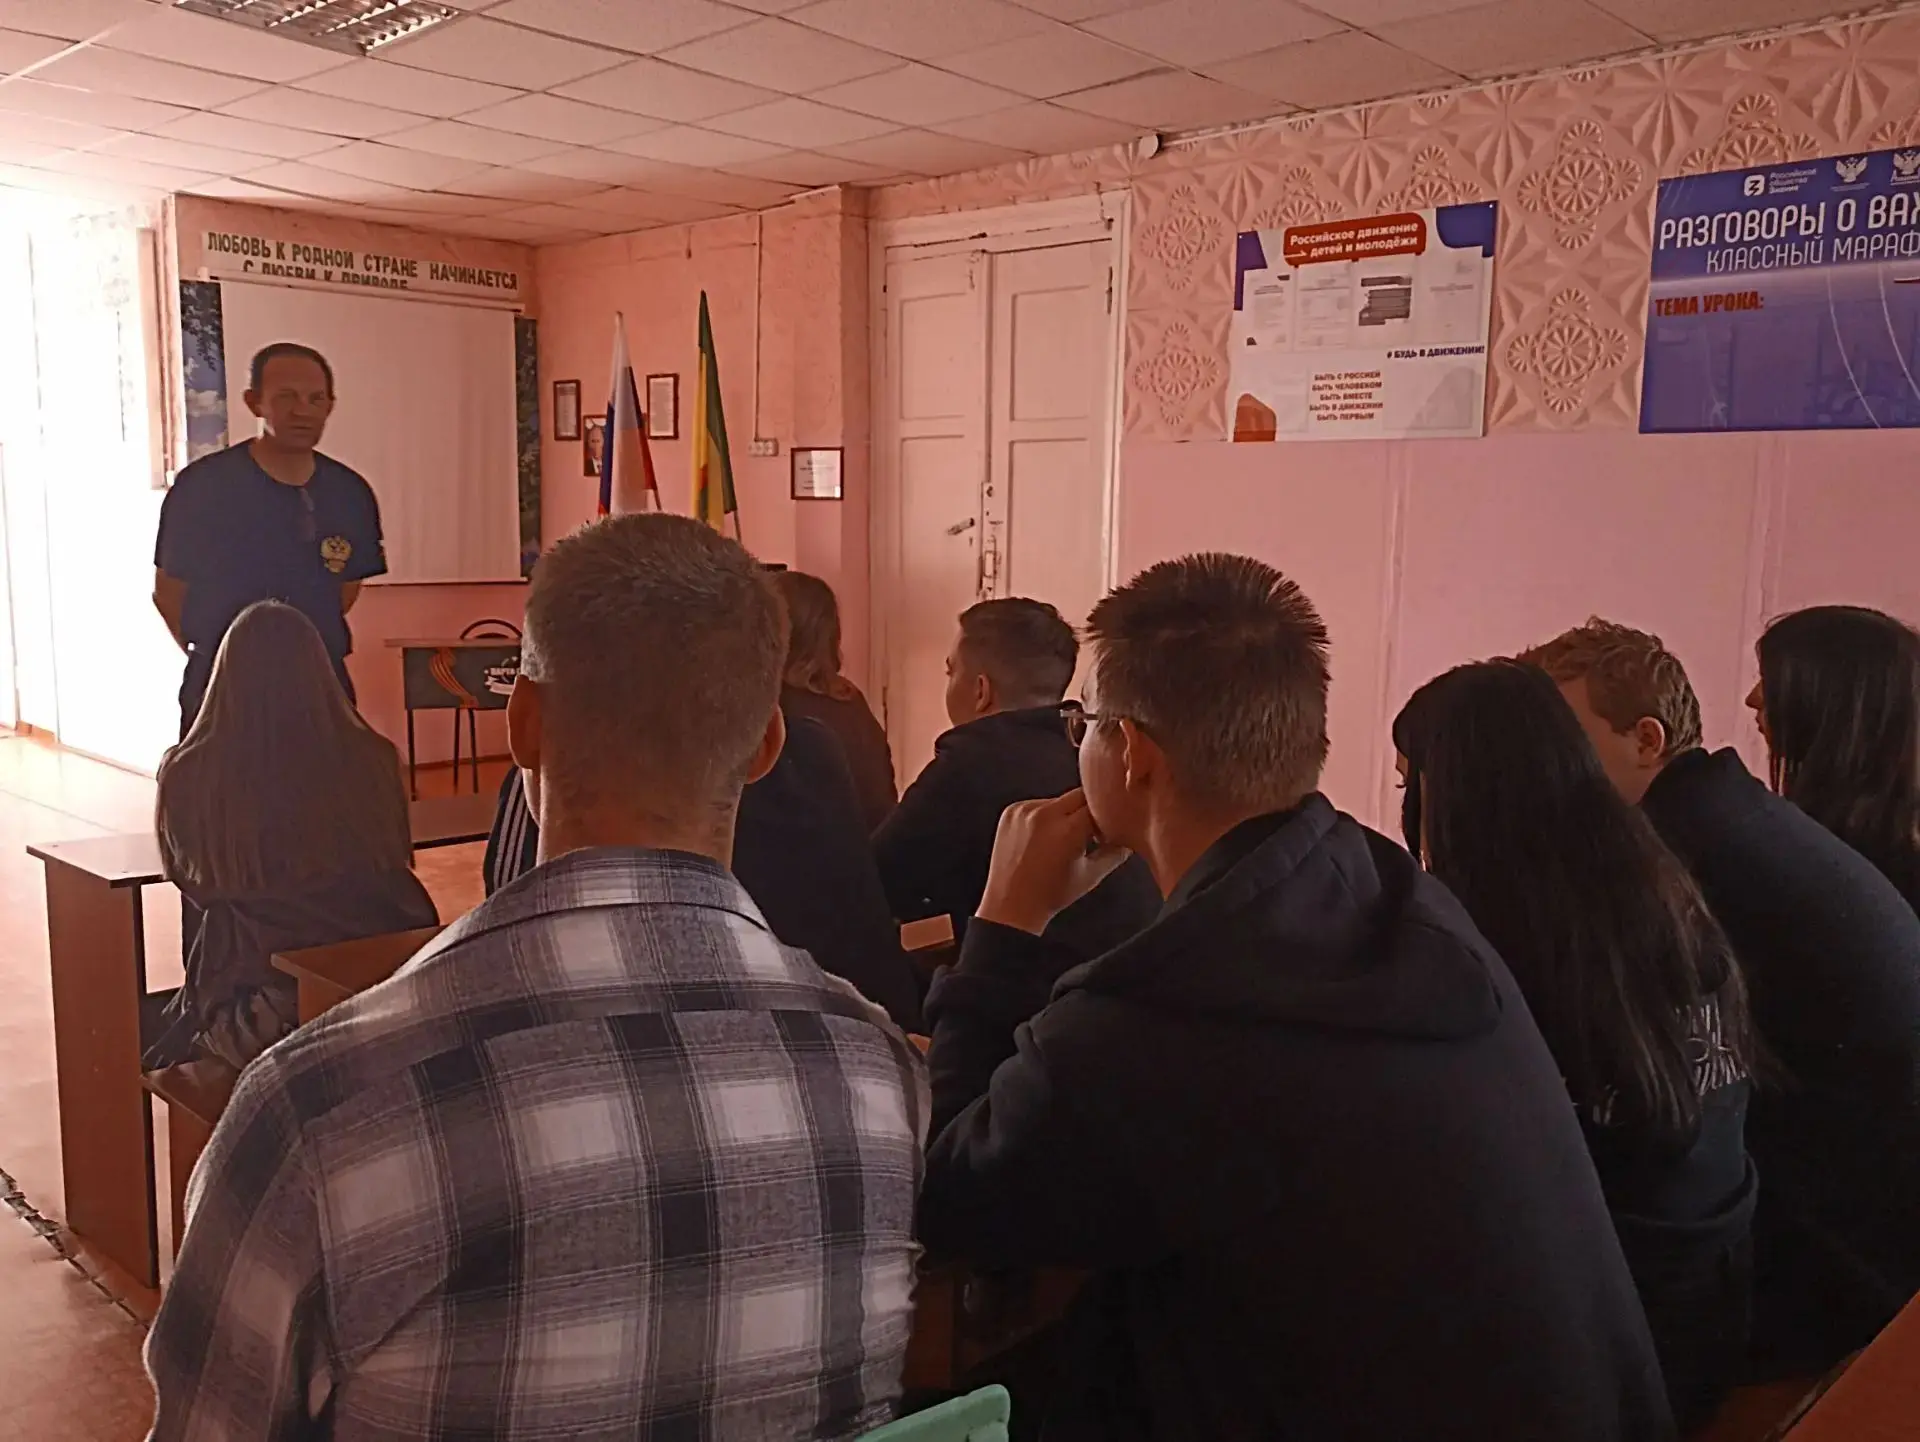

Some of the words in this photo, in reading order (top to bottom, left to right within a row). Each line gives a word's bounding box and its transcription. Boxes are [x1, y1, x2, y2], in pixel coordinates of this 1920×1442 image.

[1659, 202, 1826, 250] РАЗГОВОРЫ
[1836, 198, 1857, 232] О
[1290, 230, 1355, 246] Российское
[1357, 222, 1419, 240] движение
[1310, 242, 1343, 258] детей
[1345, 243, 1354, 252] и
[1355, 236, 1418, 251] молодёжи
[1706, 235, 1823, 273] КЛАССНЫЙ
[1832, 229, 1920, 263] МАРАФ
[207, 231, 271, 258] ЛЮБОВЬ
[276, 240, 286, 261] К
[362, 253, 418, 278] СТРАНЕ
[429, 262, 518, 290] НАЧИНАЕТСЯ
[1655, 296, 1699, 318] ТЕМА
[1703, 291, 1765, 314] УРОКА:
[1394, 350, 1418, 359] БУДЬ
[1419, 348, 1426, 357] В
[1427, 345, 1485, 358] ДВИЖЕНИИ!
[1314, 373, 1336, 381] БЫТЬ
[1337, 372, 1343, 380] С
[1344, 369, 1381, 380] РОССИЕЙ
[1312, 383, 1334, 392] БЫТЬ
[1335, 381, 1382, 390] ЧЕЛОВЕКОМ
[1343, 391, 1373, 400] ВМЕСТЕ
[1309, 403, 1331, 412] БЫТЬ
[1340, 412, 1375, 421] ПЕРВЫМ
